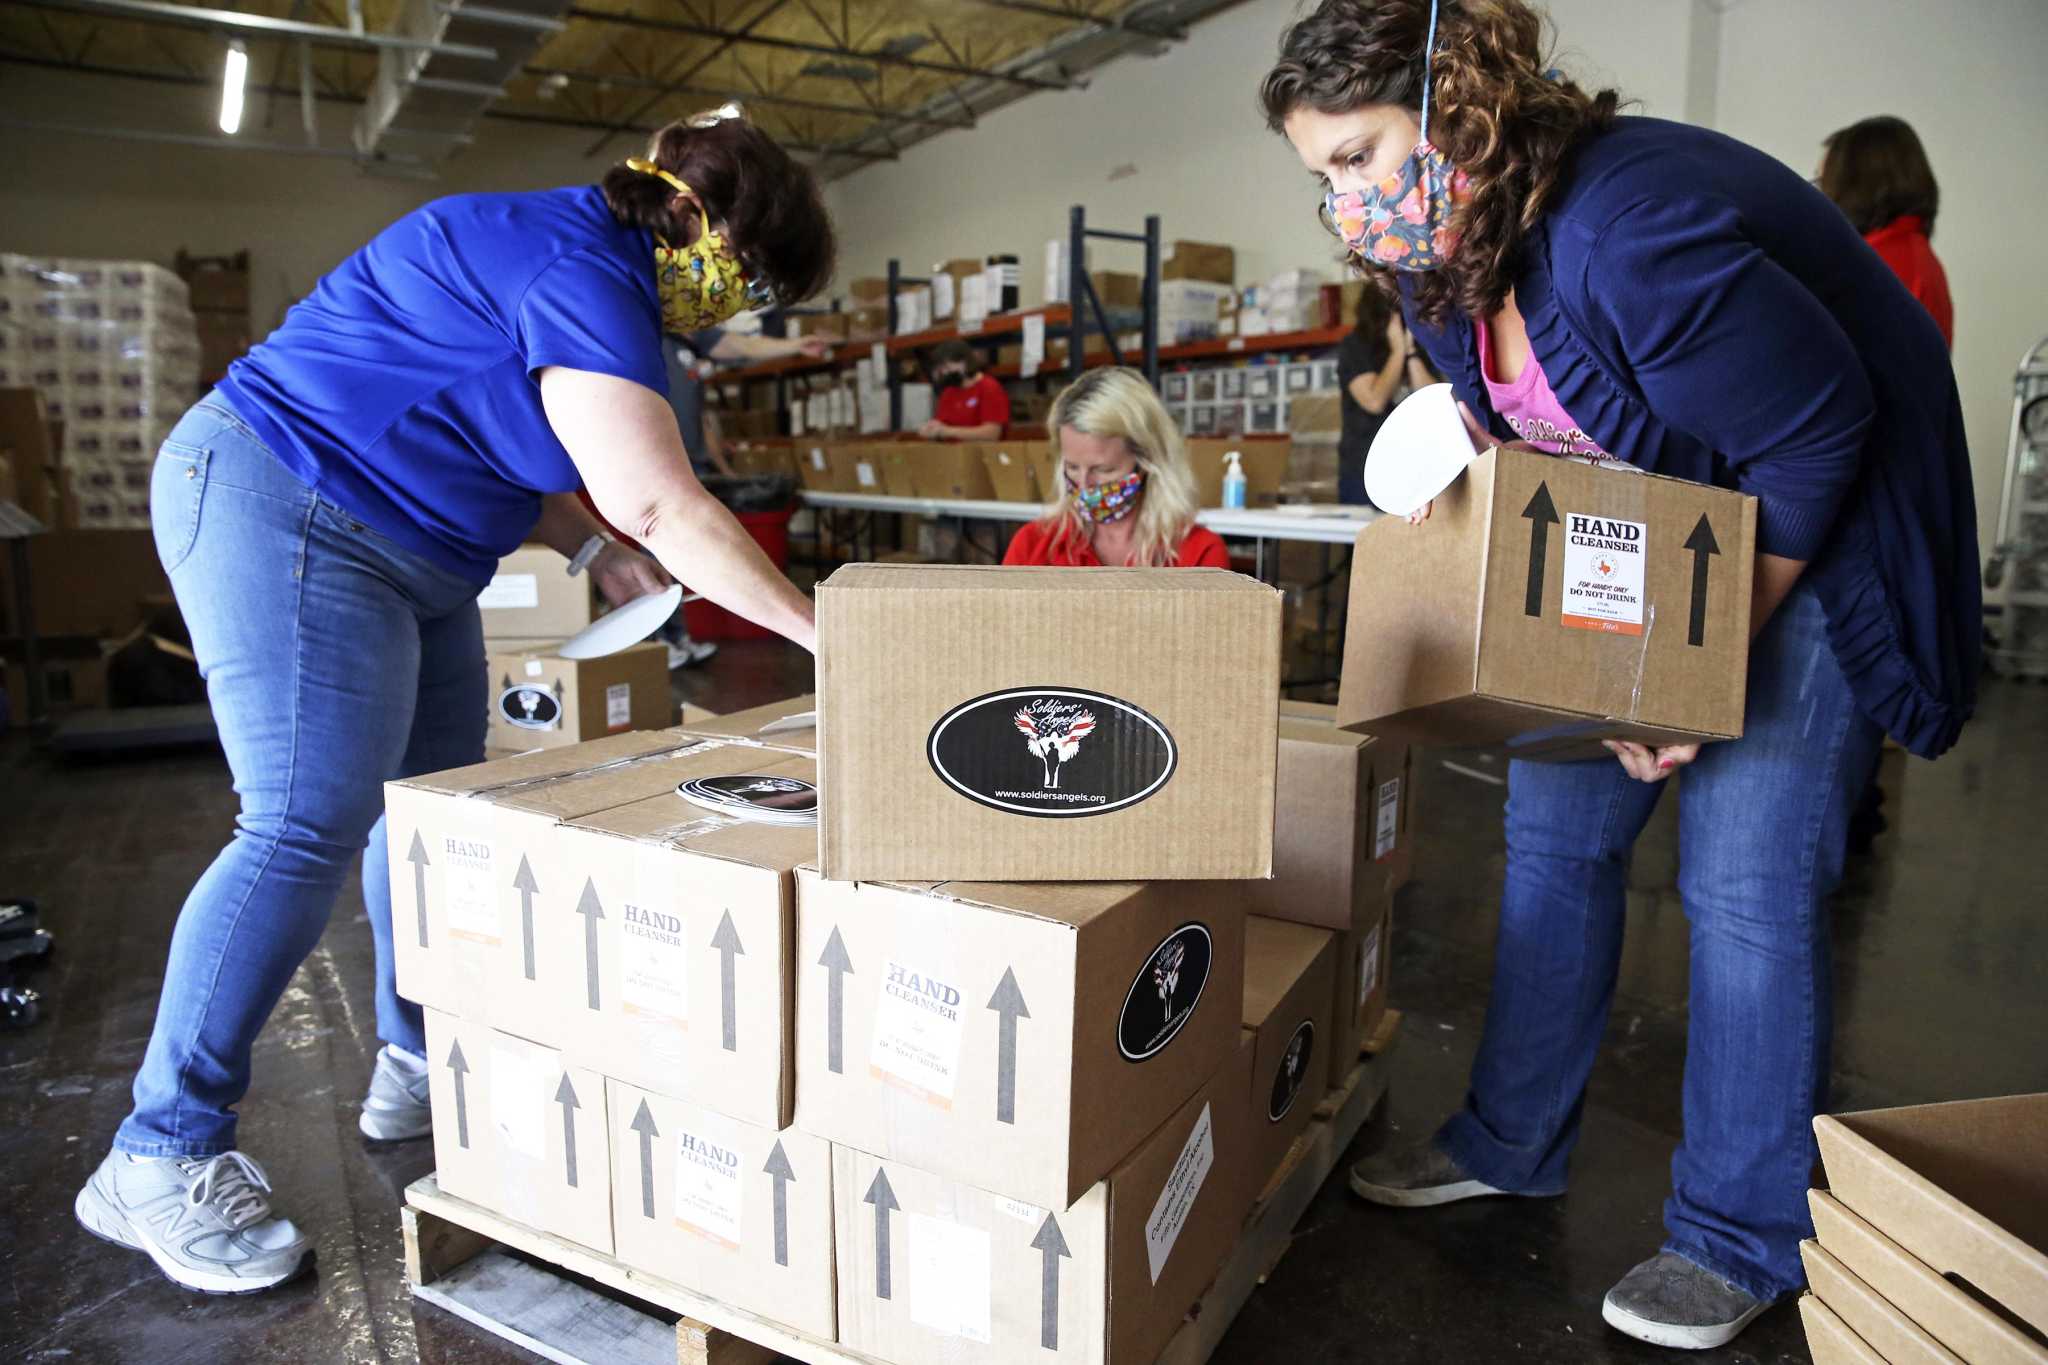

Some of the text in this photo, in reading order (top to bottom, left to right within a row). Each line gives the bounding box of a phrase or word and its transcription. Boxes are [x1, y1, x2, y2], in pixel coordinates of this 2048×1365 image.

[1571, 517, 1640, 541] HAND
[1571, 535, 1640, 553] CLEANSER
[1569, 587, 1583, 596] DO
[1585, 590, 1605, 599] NOT
[1606, 593, 1637, 604] DRINK
[1578, 580, 1591, 589] FOR
[1613, 585, 1629, 593] ONLY
[995, 789, 1106, 804] www.soldiersangels.org
[445, 838, 490, 859] HAND
[624, 904, 681, 933] HAND
[624, 923, 681, 947] CLEANSER
[887, 962, 961, 1007] HAND
[885, 983, 957, 1022] CLEANSER
[682, 1133, 738, 1168] HAND
[680, 1150, 737, 1180] CLEANSER
